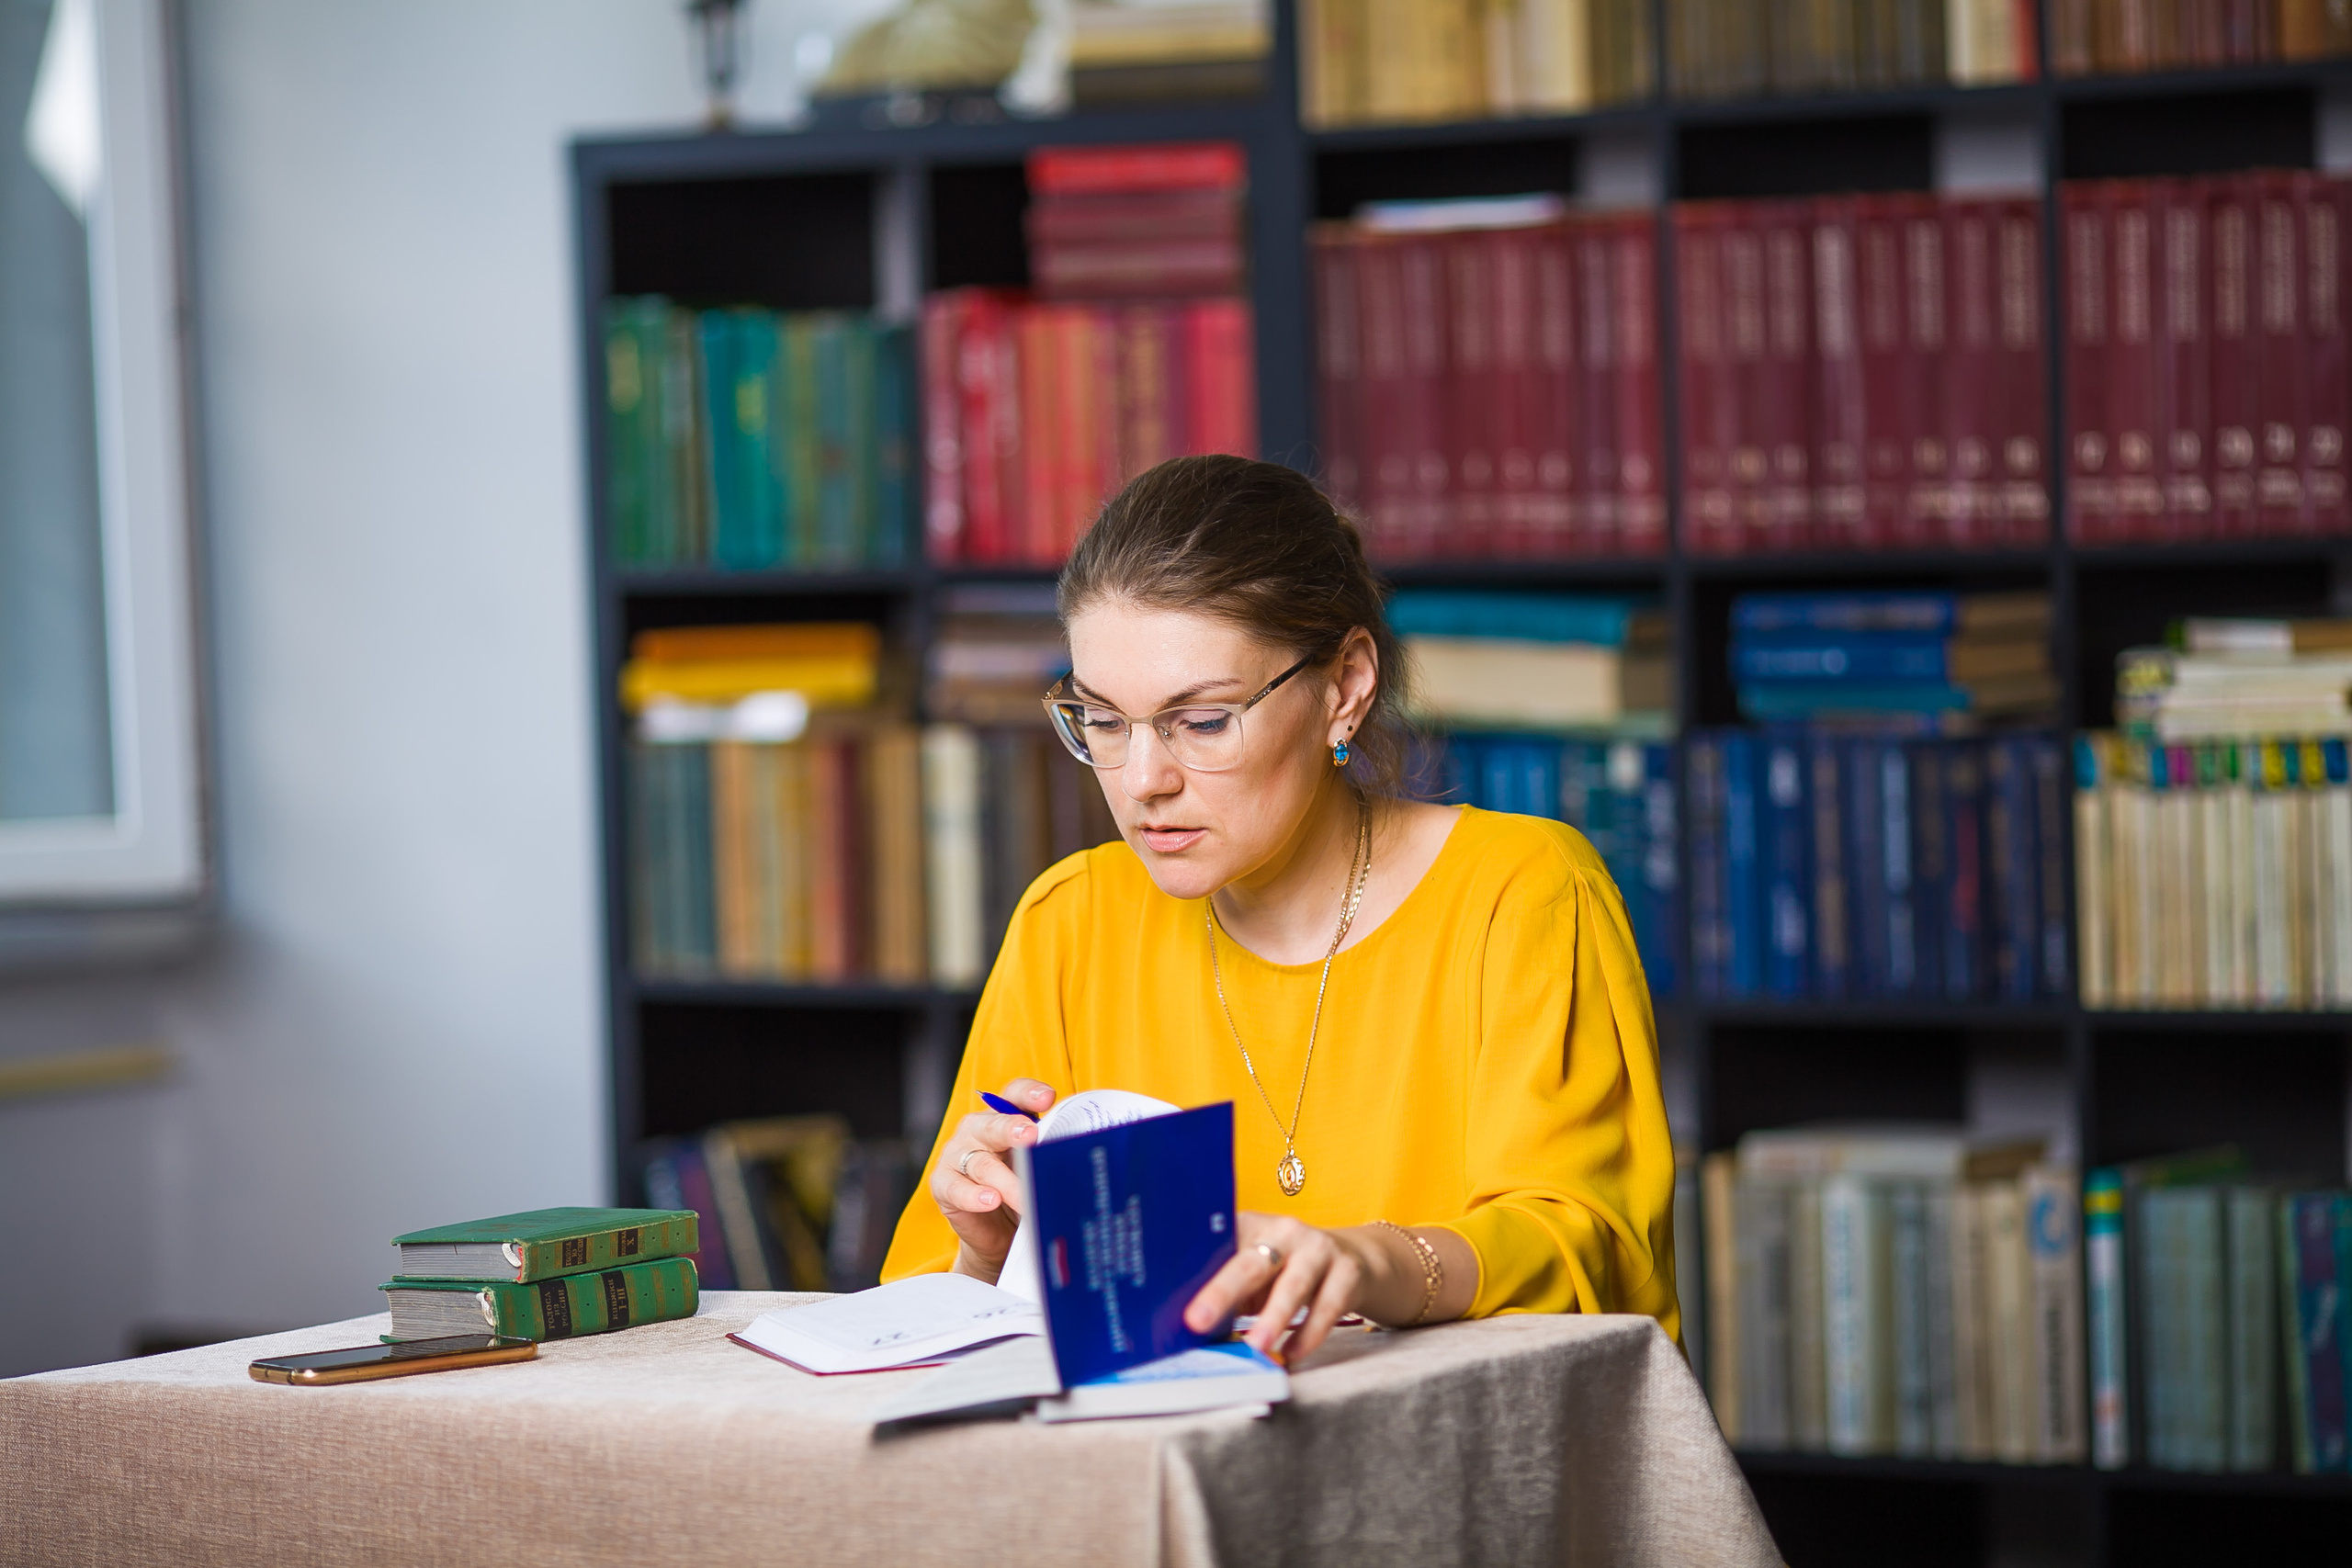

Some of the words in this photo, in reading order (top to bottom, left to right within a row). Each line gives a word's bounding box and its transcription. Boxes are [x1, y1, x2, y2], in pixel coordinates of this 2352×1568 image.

[545, 1292, 555, 1329] ГОЛОСА
[554, 1303, 560, 1315] ИЗ
[558, 1289, 569, 1326] РОССИИ
[608, 1280, 618, 1320] КНИЖКИ
